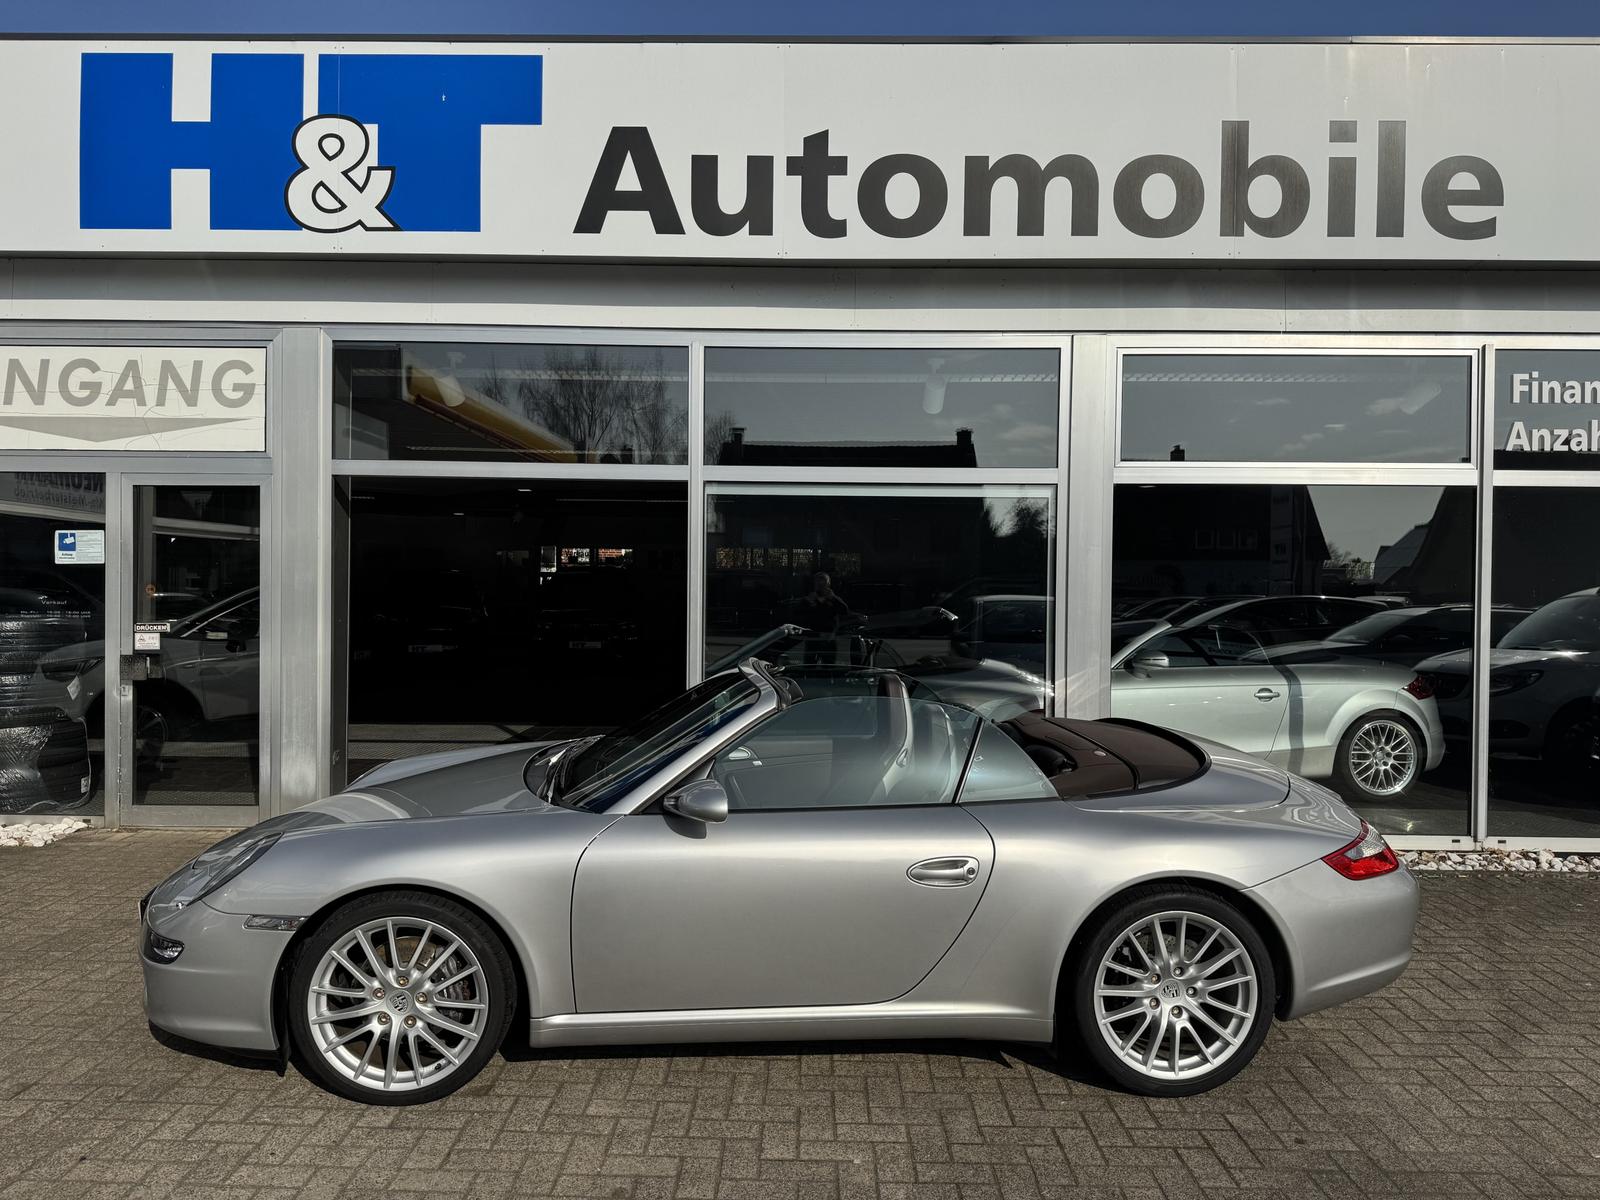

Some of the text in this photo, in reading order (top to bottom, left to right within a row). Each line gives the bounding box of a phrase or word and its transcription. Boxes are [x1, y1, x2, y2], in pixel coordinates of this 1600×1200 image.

[80, 52, 543, 233] H&T
[573, 120, 1506, 241] Automobile
[2, 358, 257, 408] NGANG
[1512, 371, 1600, 404] Finan
